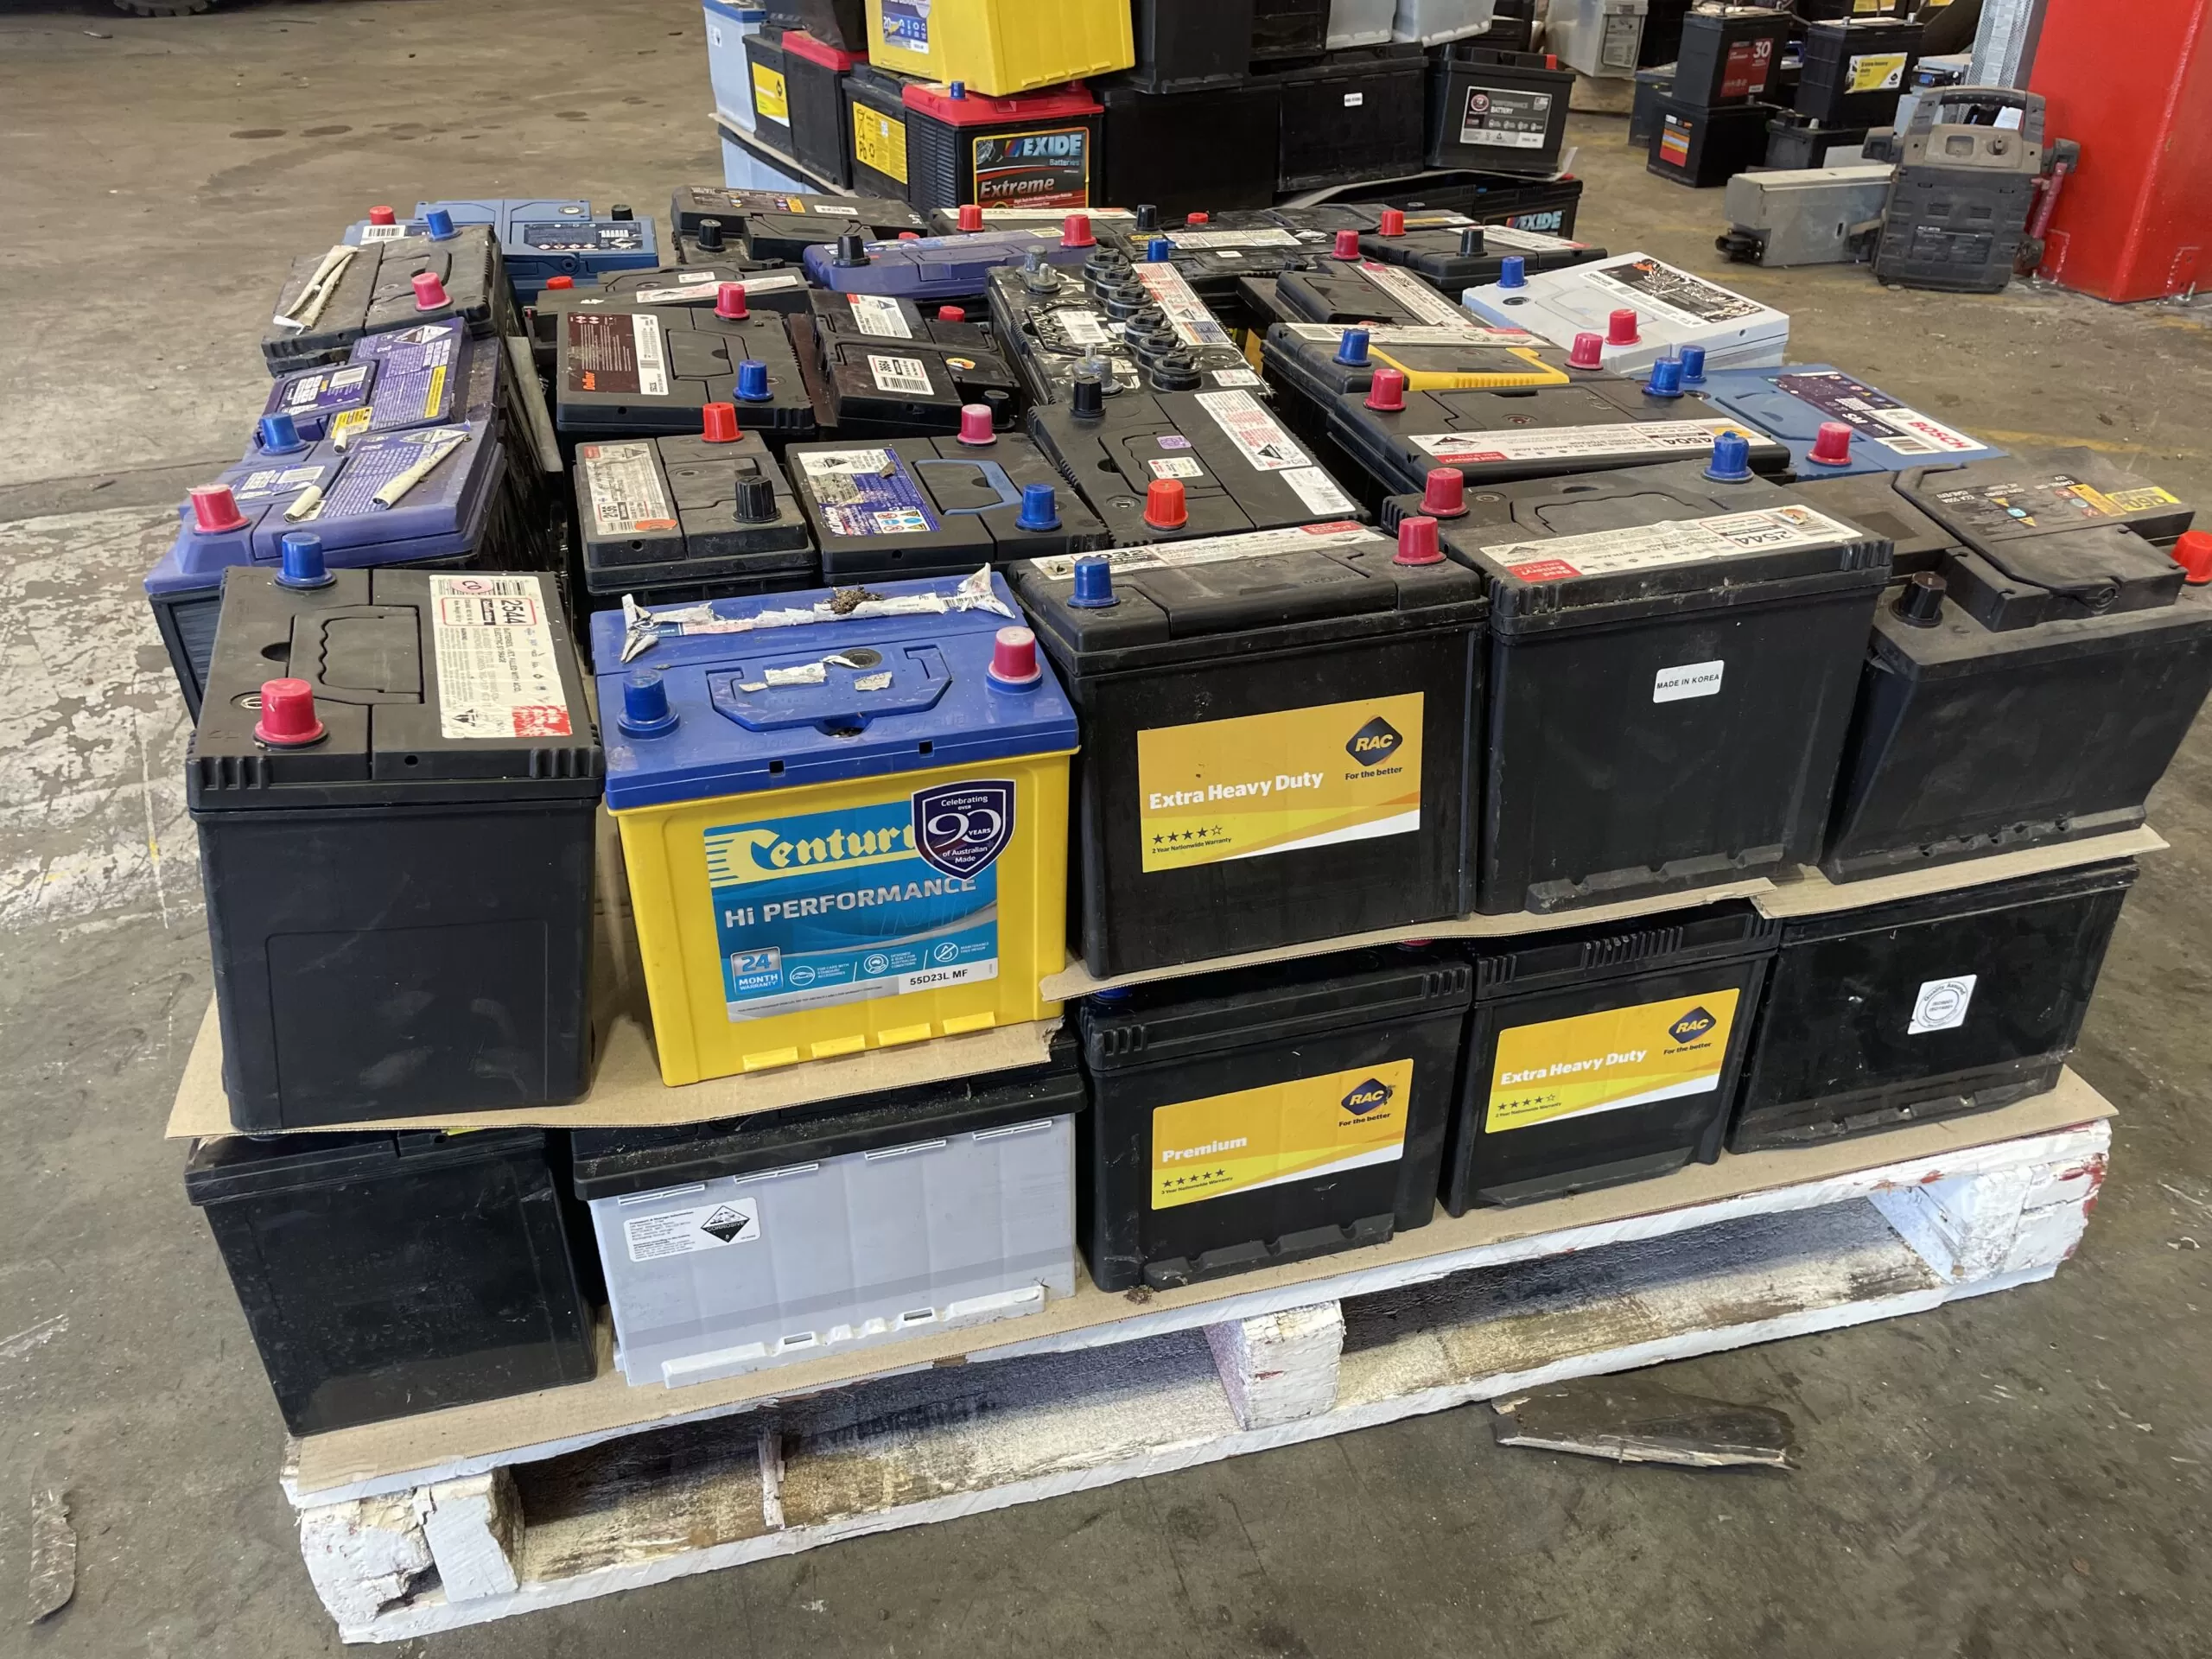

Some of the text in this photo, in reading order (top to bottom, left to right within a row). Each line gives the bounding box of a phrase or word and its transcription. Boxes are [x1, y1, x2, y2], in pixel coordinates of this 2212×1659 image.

[1753, 41, 1771, 59] 30
[1022, 135, 1082, 156] EXIDE
[980, 177, 1055, 199] Extreme
[1521, 211, 1562, 230] EXIDE
[1663, 437, 1712, 446] 4504
[1908, 422, 1972, 448] BOSCH
[1734, 531, 1792, 545] 2544
[1522, 565, 1567, 575] Battery?
[501, 601, 526, 624] 2544
[1656, 679, 1679, 689] MADE
[1692, 674, 1719, 684] KOREA
[1355, 734, 1393, 752] RAC
[1376, 767, 1403, 776] better
[1149, 772, 1324, 810] Extra Heavy Duty
[941, 796, 988, 807] Celebrating
[928, 809, 1001, 849] 90
[969, 828, 992, 836] YEARS
[951, 846, 988, 856] Australian
[1157, 844, 1170, 853] Year
[1171, 841, 1205, 851] Nationwide
[1205, 836, 1232, 847] Warranty
[724, 878, 977, 928] Hi PERFORMANCE
[741, 953, 772, 972] 24
[739, 973, 778, 986] MONTH
[910, 969, 968, 986] 55D23L MF
[740, 981, 778, 991] WARRANTY
[1924, 986, 1944, 1001] Quality
[1675, 1019, 1708, 1033] RAC
[1501, 1050, 1647, 1085] Extra Heavy Duty
[1350, 1090, 1384, 1105] RAC
[1367, 1113, 1391, 1122] better
[1162, 1137, 1248, 1163] Premium
[1178, 1182, 1208, 1192] Nationwide
[1209, 1177, 1233, 1185] Warranty
[707, 1221, 745, 1232] CORROSIVE
